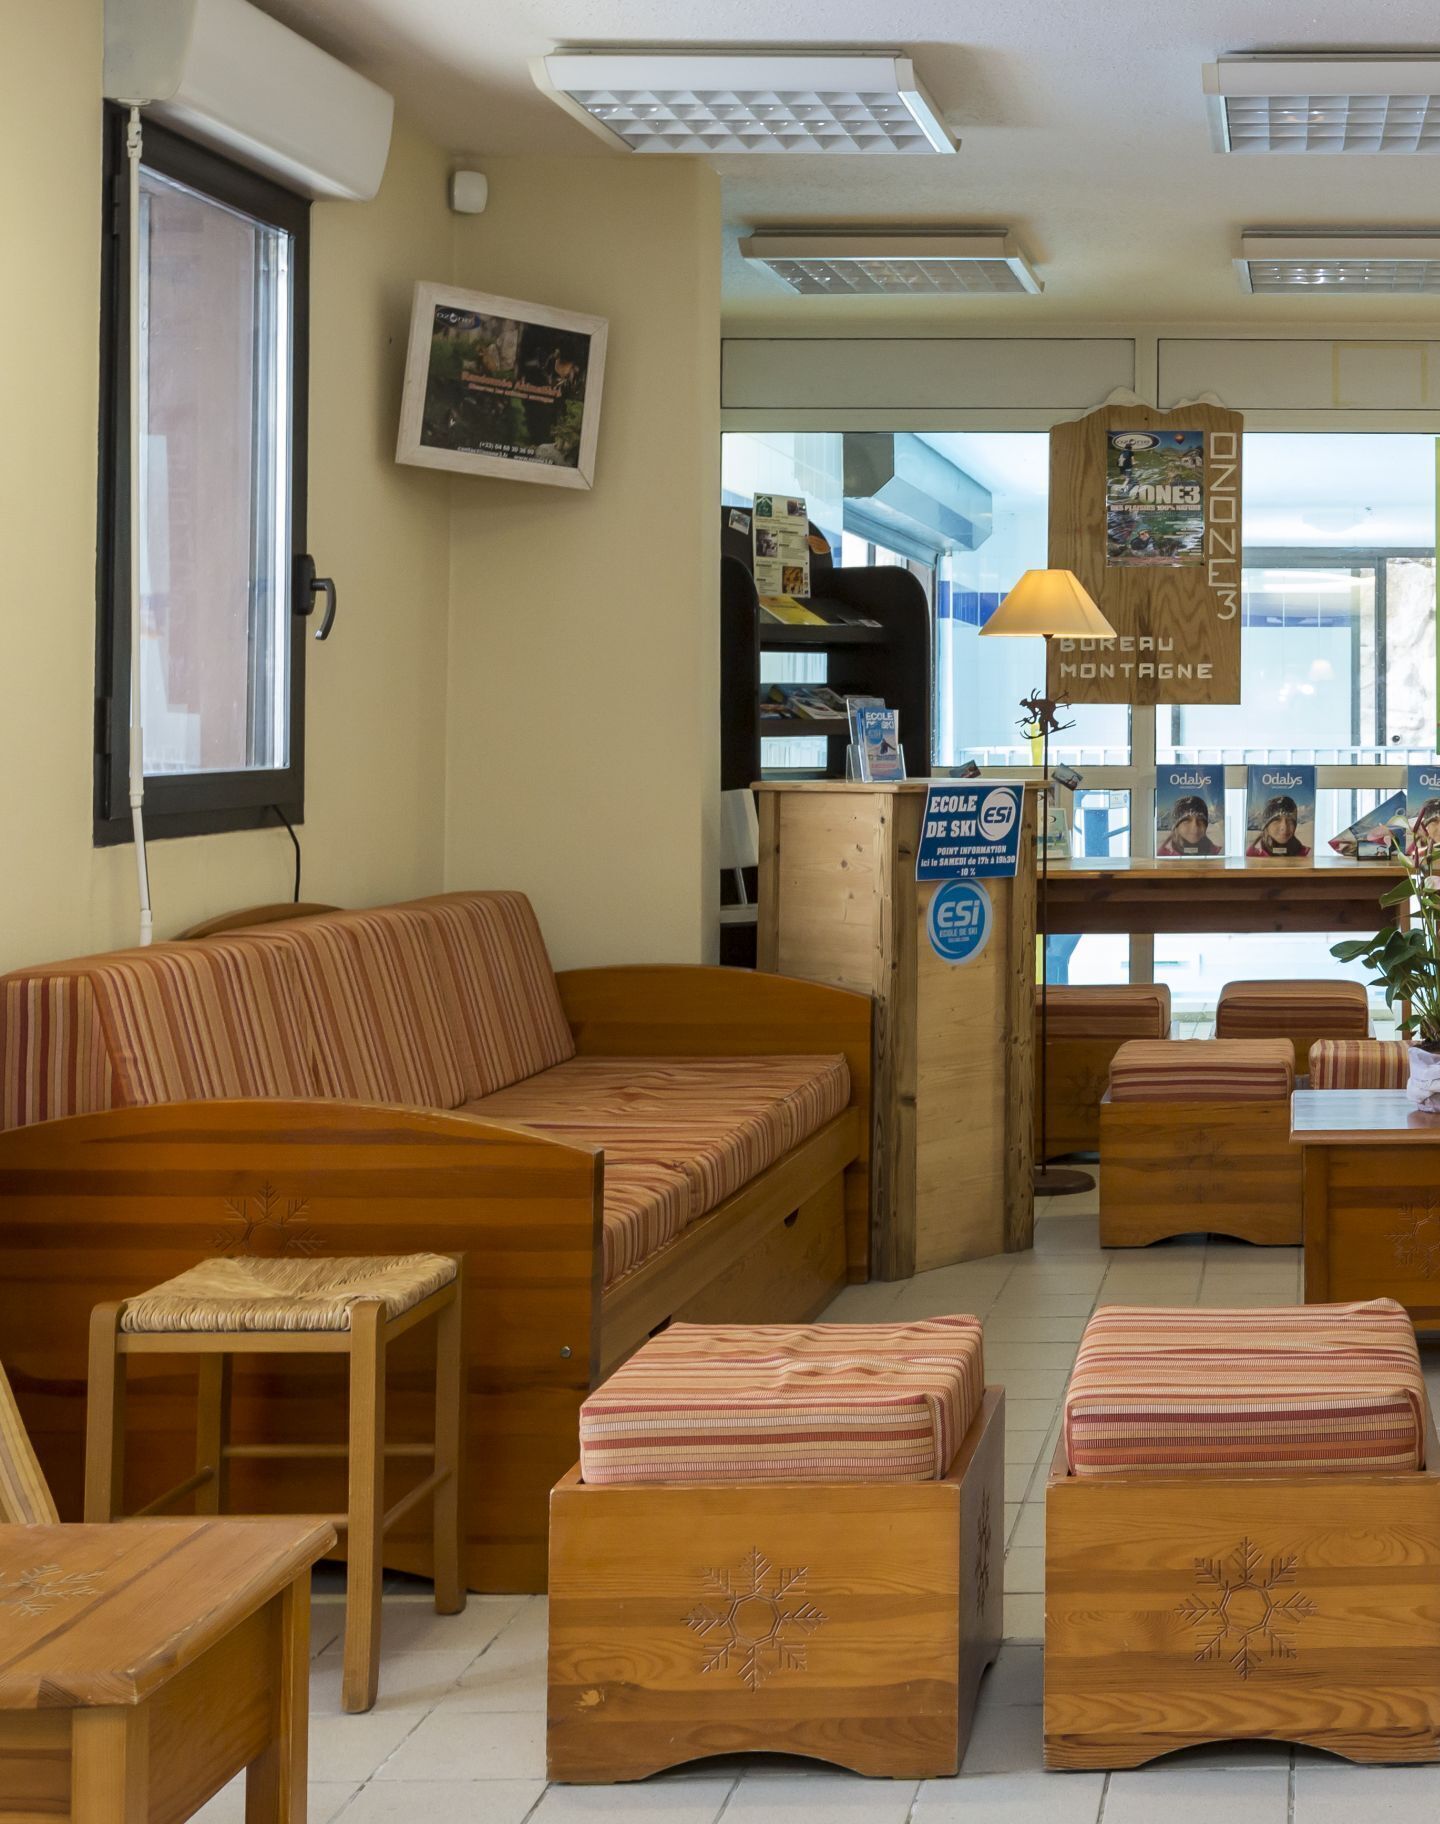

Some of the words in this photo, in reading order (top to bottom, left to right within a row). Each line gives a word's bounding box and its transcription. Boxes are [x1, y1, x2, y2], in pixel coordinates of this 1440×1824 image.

[1208, 432, 1237, 620] OZONE3
[1059, 636, 1174, 653] BUREAU
[1060, 663, 1213, 679] MONTAGNE
[865, 712, 894, 721] ECOLE
[1170, 772, 1212, 789] Odalys
[1262, 772, 1303, 789] Odalys
[929, 795, 978, 813] ECOLE
[926, 820, 948, 838] DE
[950, 819, 976, 838] SKI
[936, 847, 959, 856] POINT
[959, 845, 1007, 855] INFORMATION
[931, 858, 938, 867] le
[938, 857, 967, 866] SAMEDI
[967, 856, 977, 865] de
[977, 856, 989, 865] 17h
[990, 856, 995, 864] à
[995, 855, 1016, 864] 19h30
[969, 867, 976, 876] %
